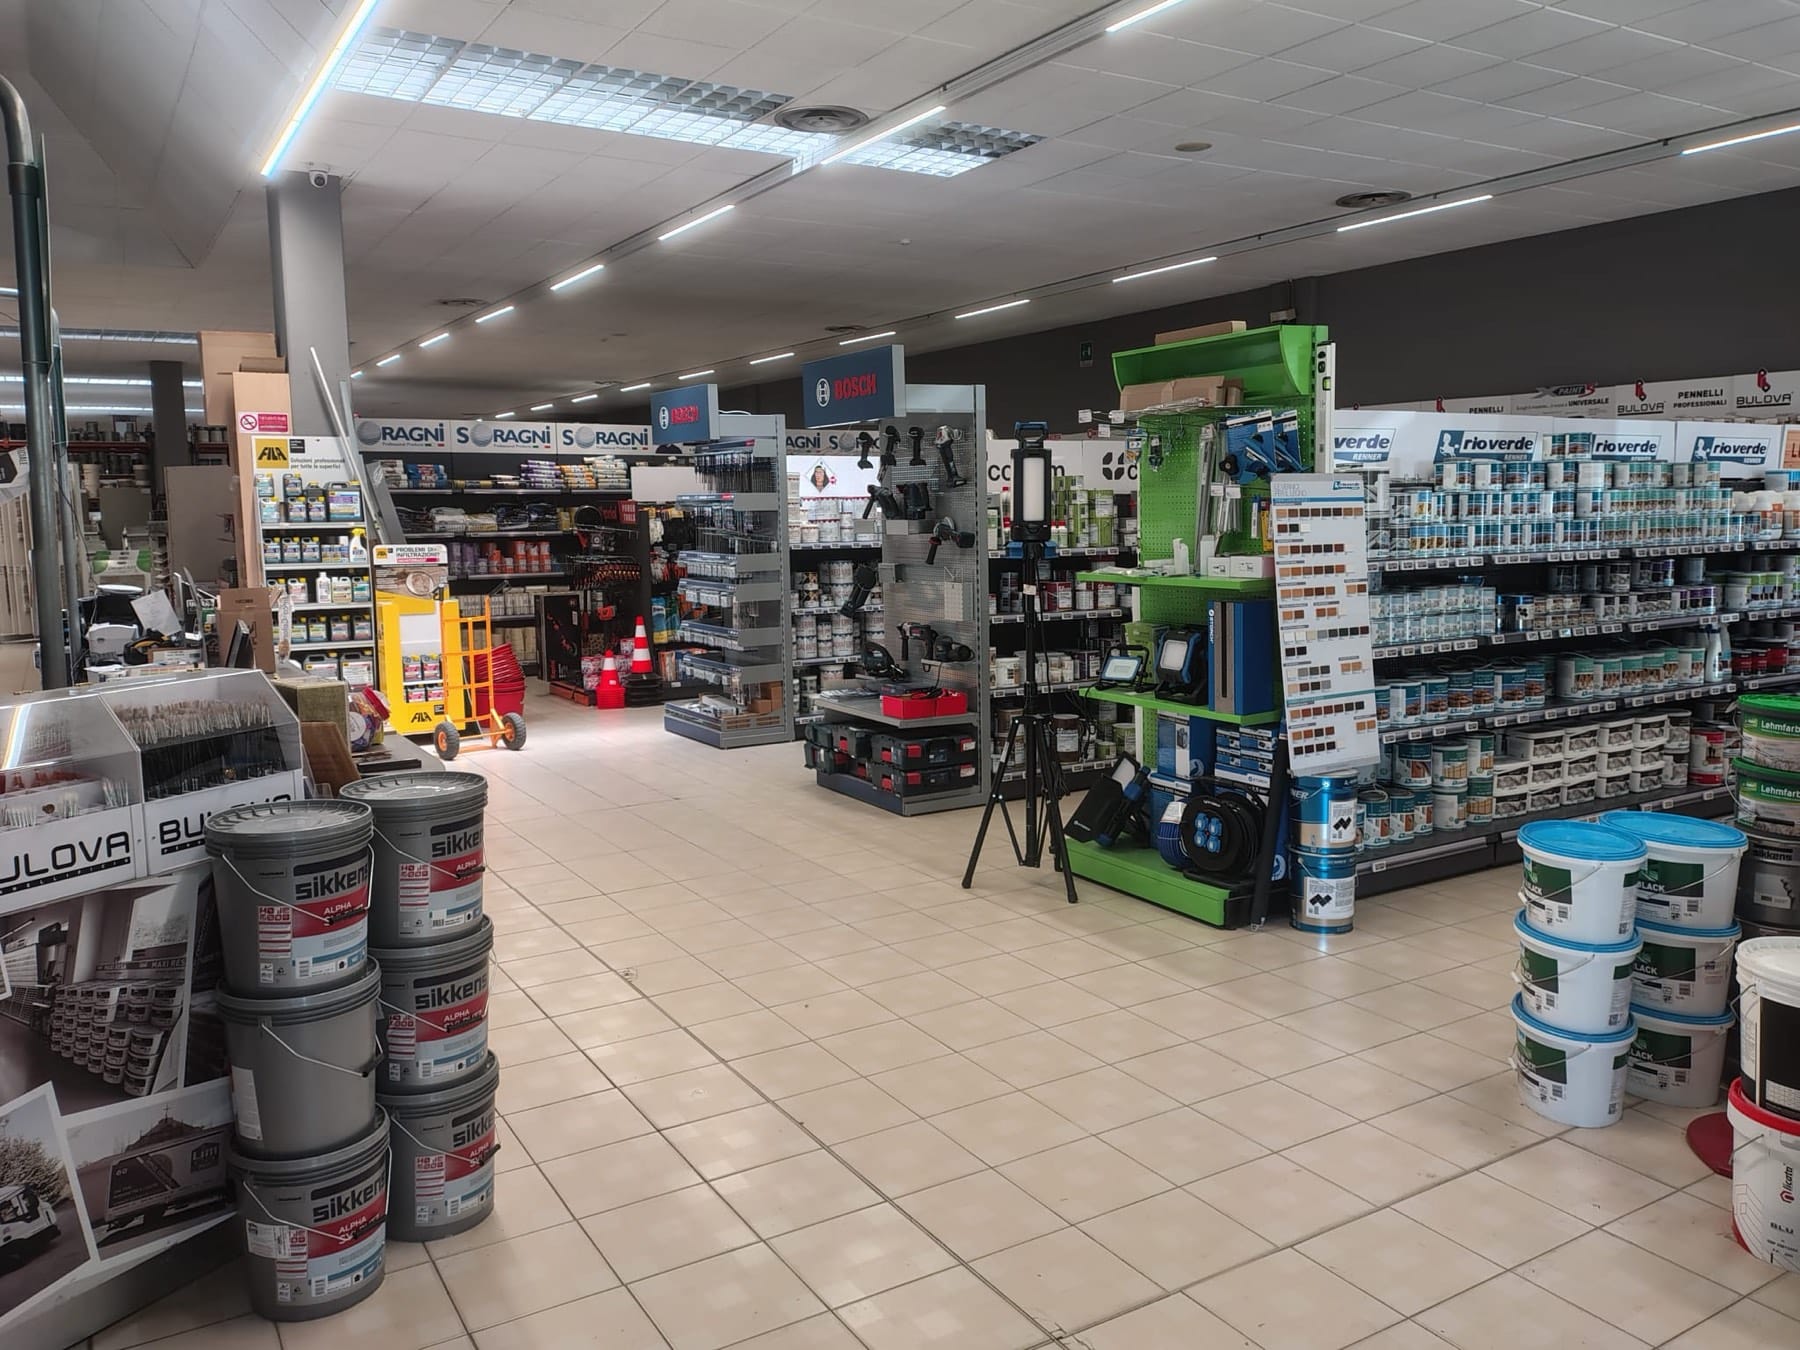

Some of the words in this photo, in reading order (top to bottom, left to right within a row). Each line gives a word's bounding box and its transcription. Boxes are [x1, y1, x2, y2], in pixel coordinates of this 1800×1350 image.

[834, 373, 877, 399] BOSCH
[1678, 389, 1724, 399] PENNELLI
[1736, 393, 1792, 406] BULOVA
[1568, 398, 1609, 406] UNIVERSALE
[1617, 403, 1665, 414] BULOVA
[1673, 399, 1727, 408] PROFESSIONALI
[1469, 406, 1504, 414] PENNELLI
[1334, 434, 1390, 449] verde
[1462, 436, 1534, 451] rioverde
[1595, 440, 1657, 453] rioverde
[258, 446, 288, 461] FILA
[1713, 442, 1767, 455] rioverde
[410, 712, 432, 723] FILA
[1761, 720, 1800, 733] Lehmfarb
[1760, 784, 1800, 798] Lehmfarb
[432, 828, 483, 858] sikke
[0, 831, 129, 884] ULOVA
[456, 860, 477, 871] ALPHA
[323, 902, 352, 915] ALPHA
[1633, 962, 1658, 976] LACK
[443, 1009, 470, 1022] ALPHA
[1629, 1049, 1653, 1063] LACK
[338, 1215, 367, 1234] ALPHA
